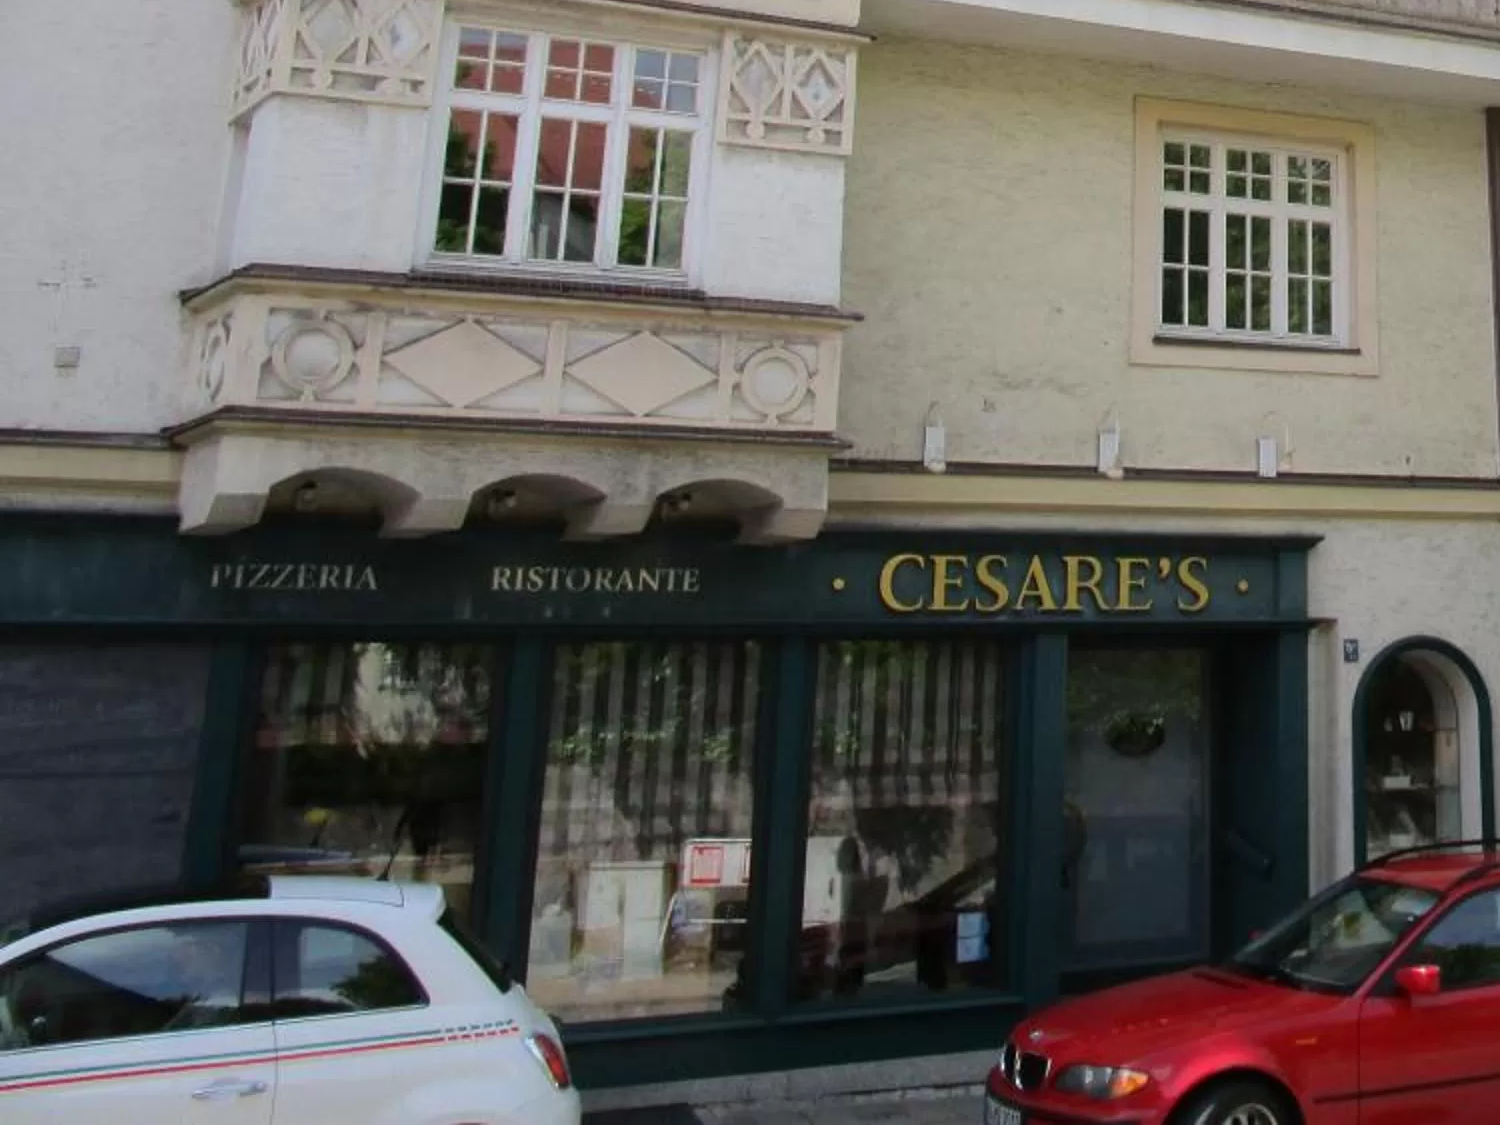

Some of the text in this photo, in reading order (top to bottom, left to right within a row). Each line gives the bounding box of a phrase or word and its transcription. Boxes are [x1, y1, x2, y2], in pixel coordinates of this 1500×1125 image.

[211, 563, 700, 592] PIZZERIA RISTORANTE
[879, 554, 1209, 612] CESARE'S
